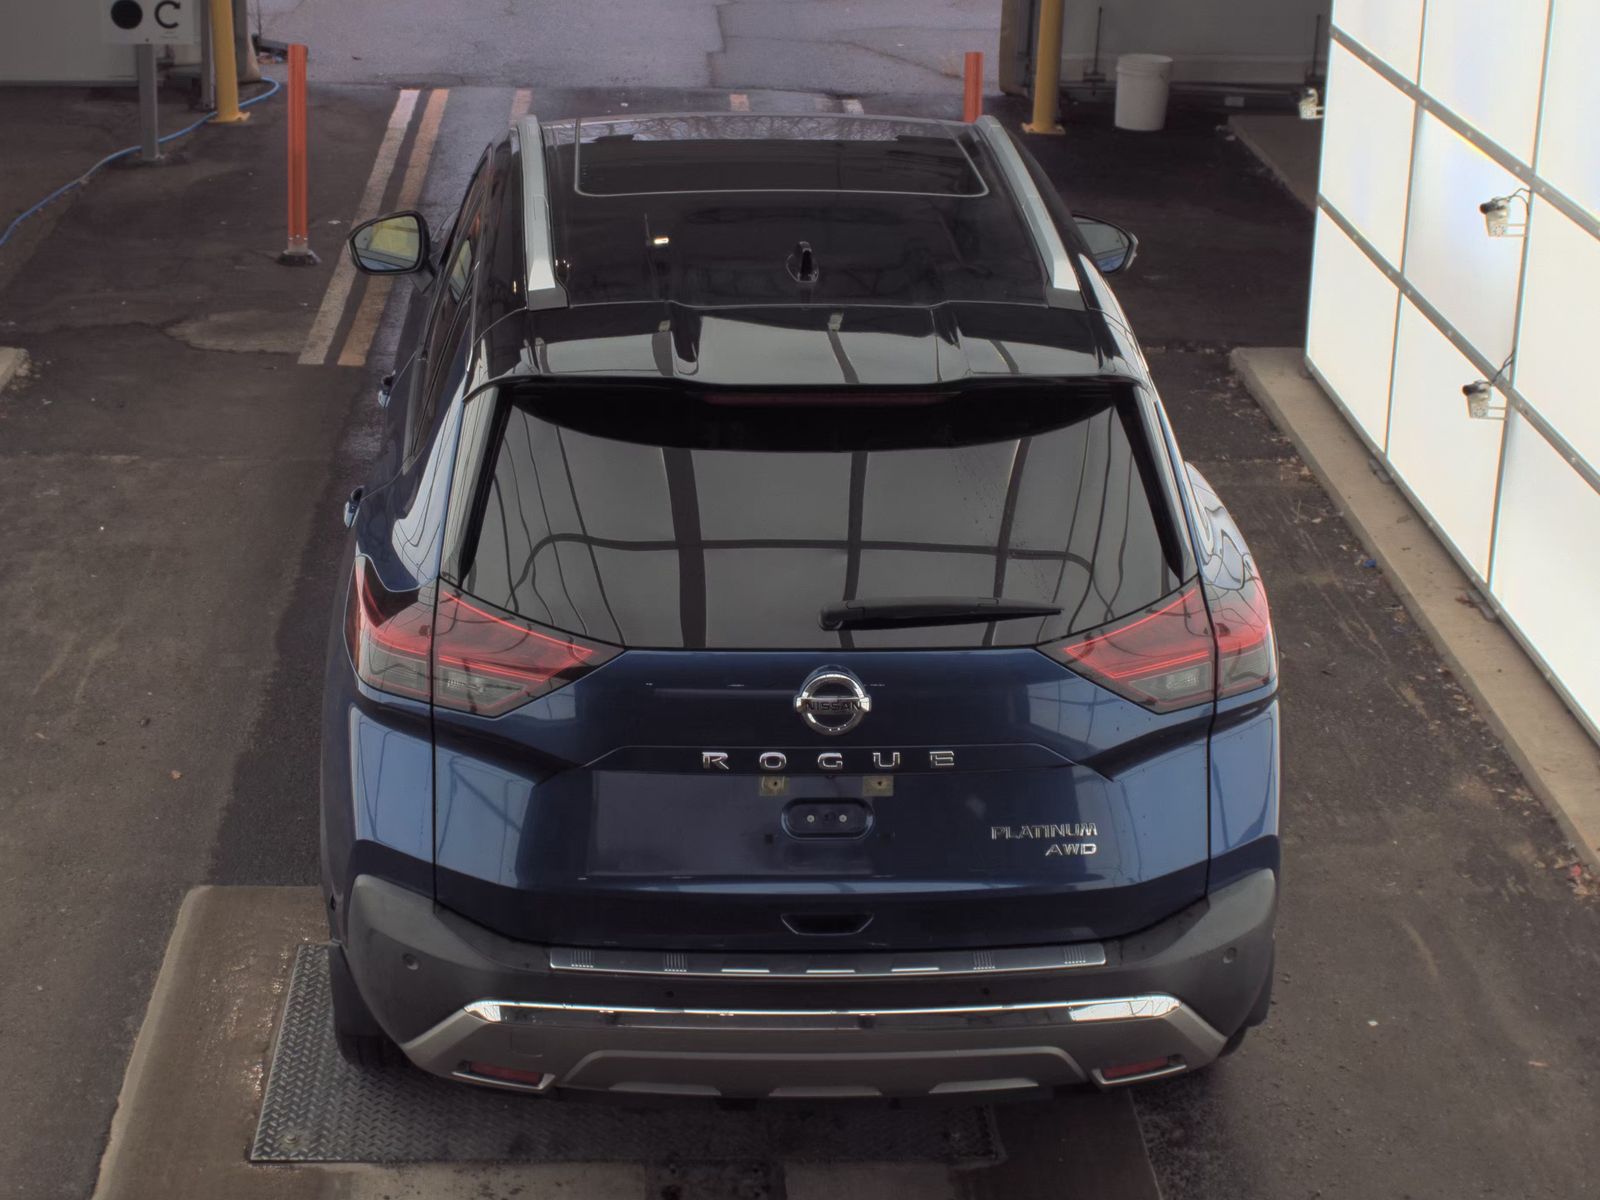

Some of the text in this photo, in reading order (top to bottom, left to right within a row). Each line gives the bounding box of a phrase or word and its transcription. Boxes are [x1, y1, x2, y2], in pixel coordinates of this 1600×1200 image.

[806, 701, 861, 711] NISSAN
[702, 751, 955, 770] ROGUE
[991, 823, 1098, 840] PLATINUM
[1045, 843, 1097, 856] AWD
